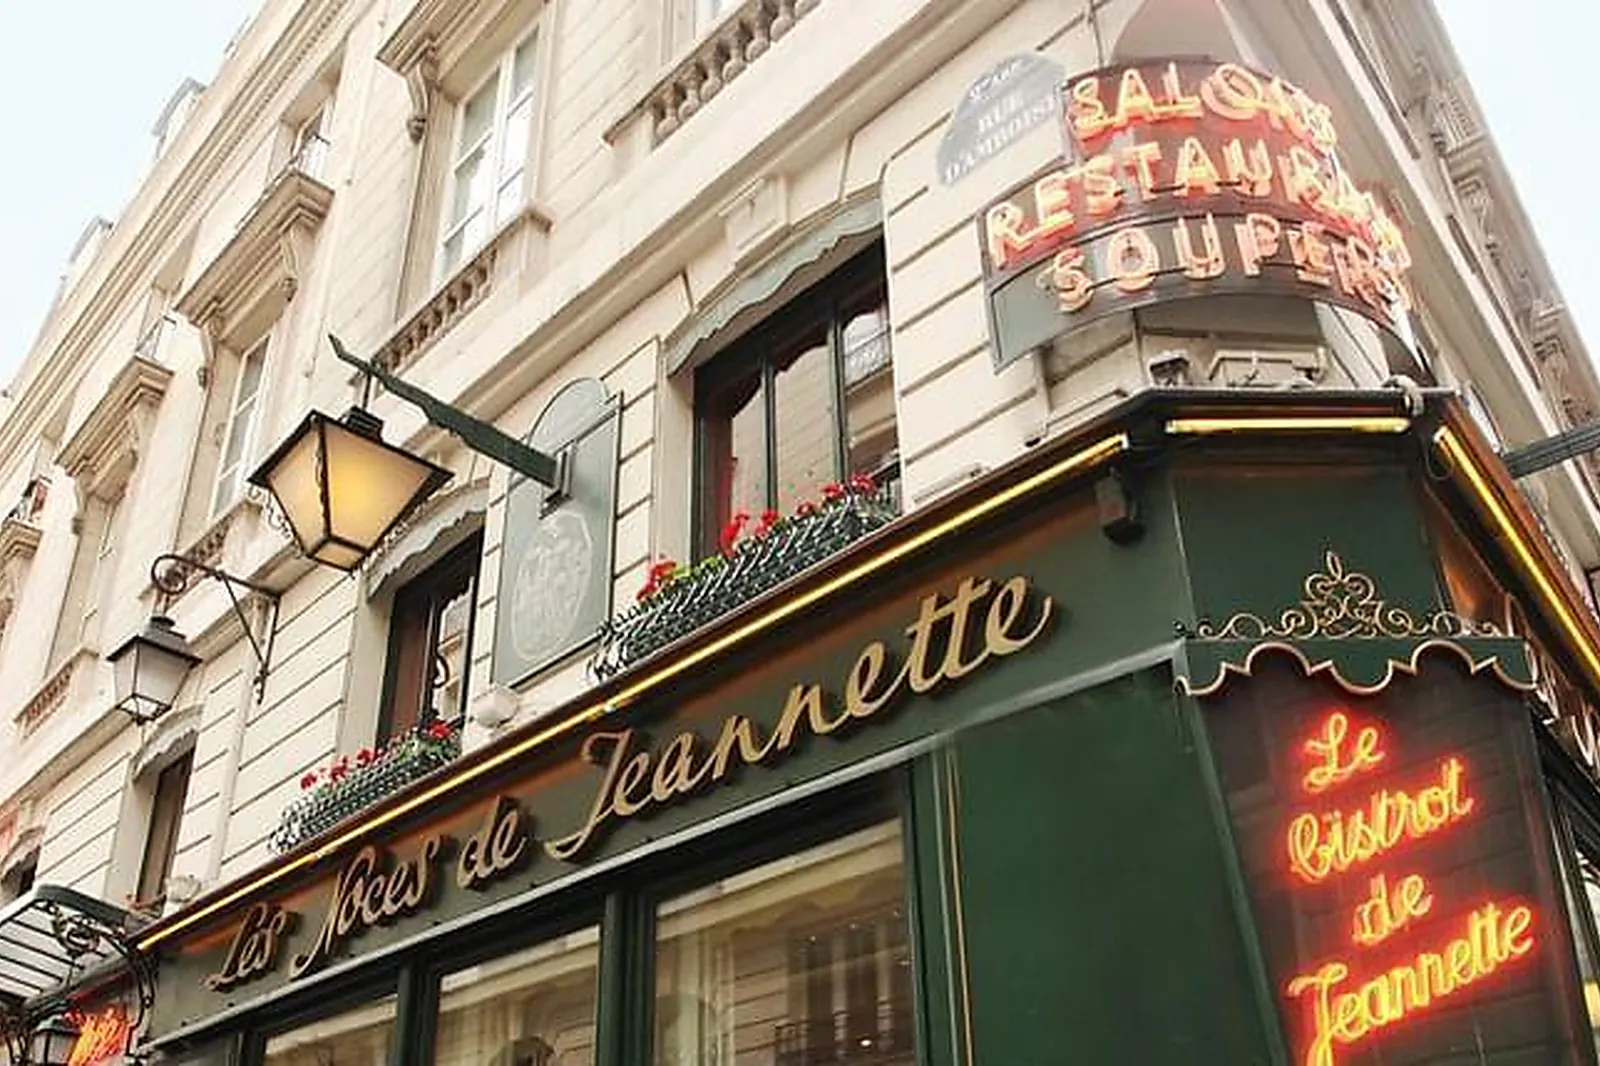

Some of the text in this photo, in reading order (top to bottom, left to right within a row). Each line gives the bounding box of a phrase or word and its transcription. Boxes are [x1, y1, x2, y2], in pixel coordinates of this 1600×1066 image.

[202, 575, 1053, 990] Les Noces de Jeannette
[1303, 712, 1385, 792] Le
[1352, 873, 1433, 947] de
[1288, 902, 1534, 1066] Jeannette
